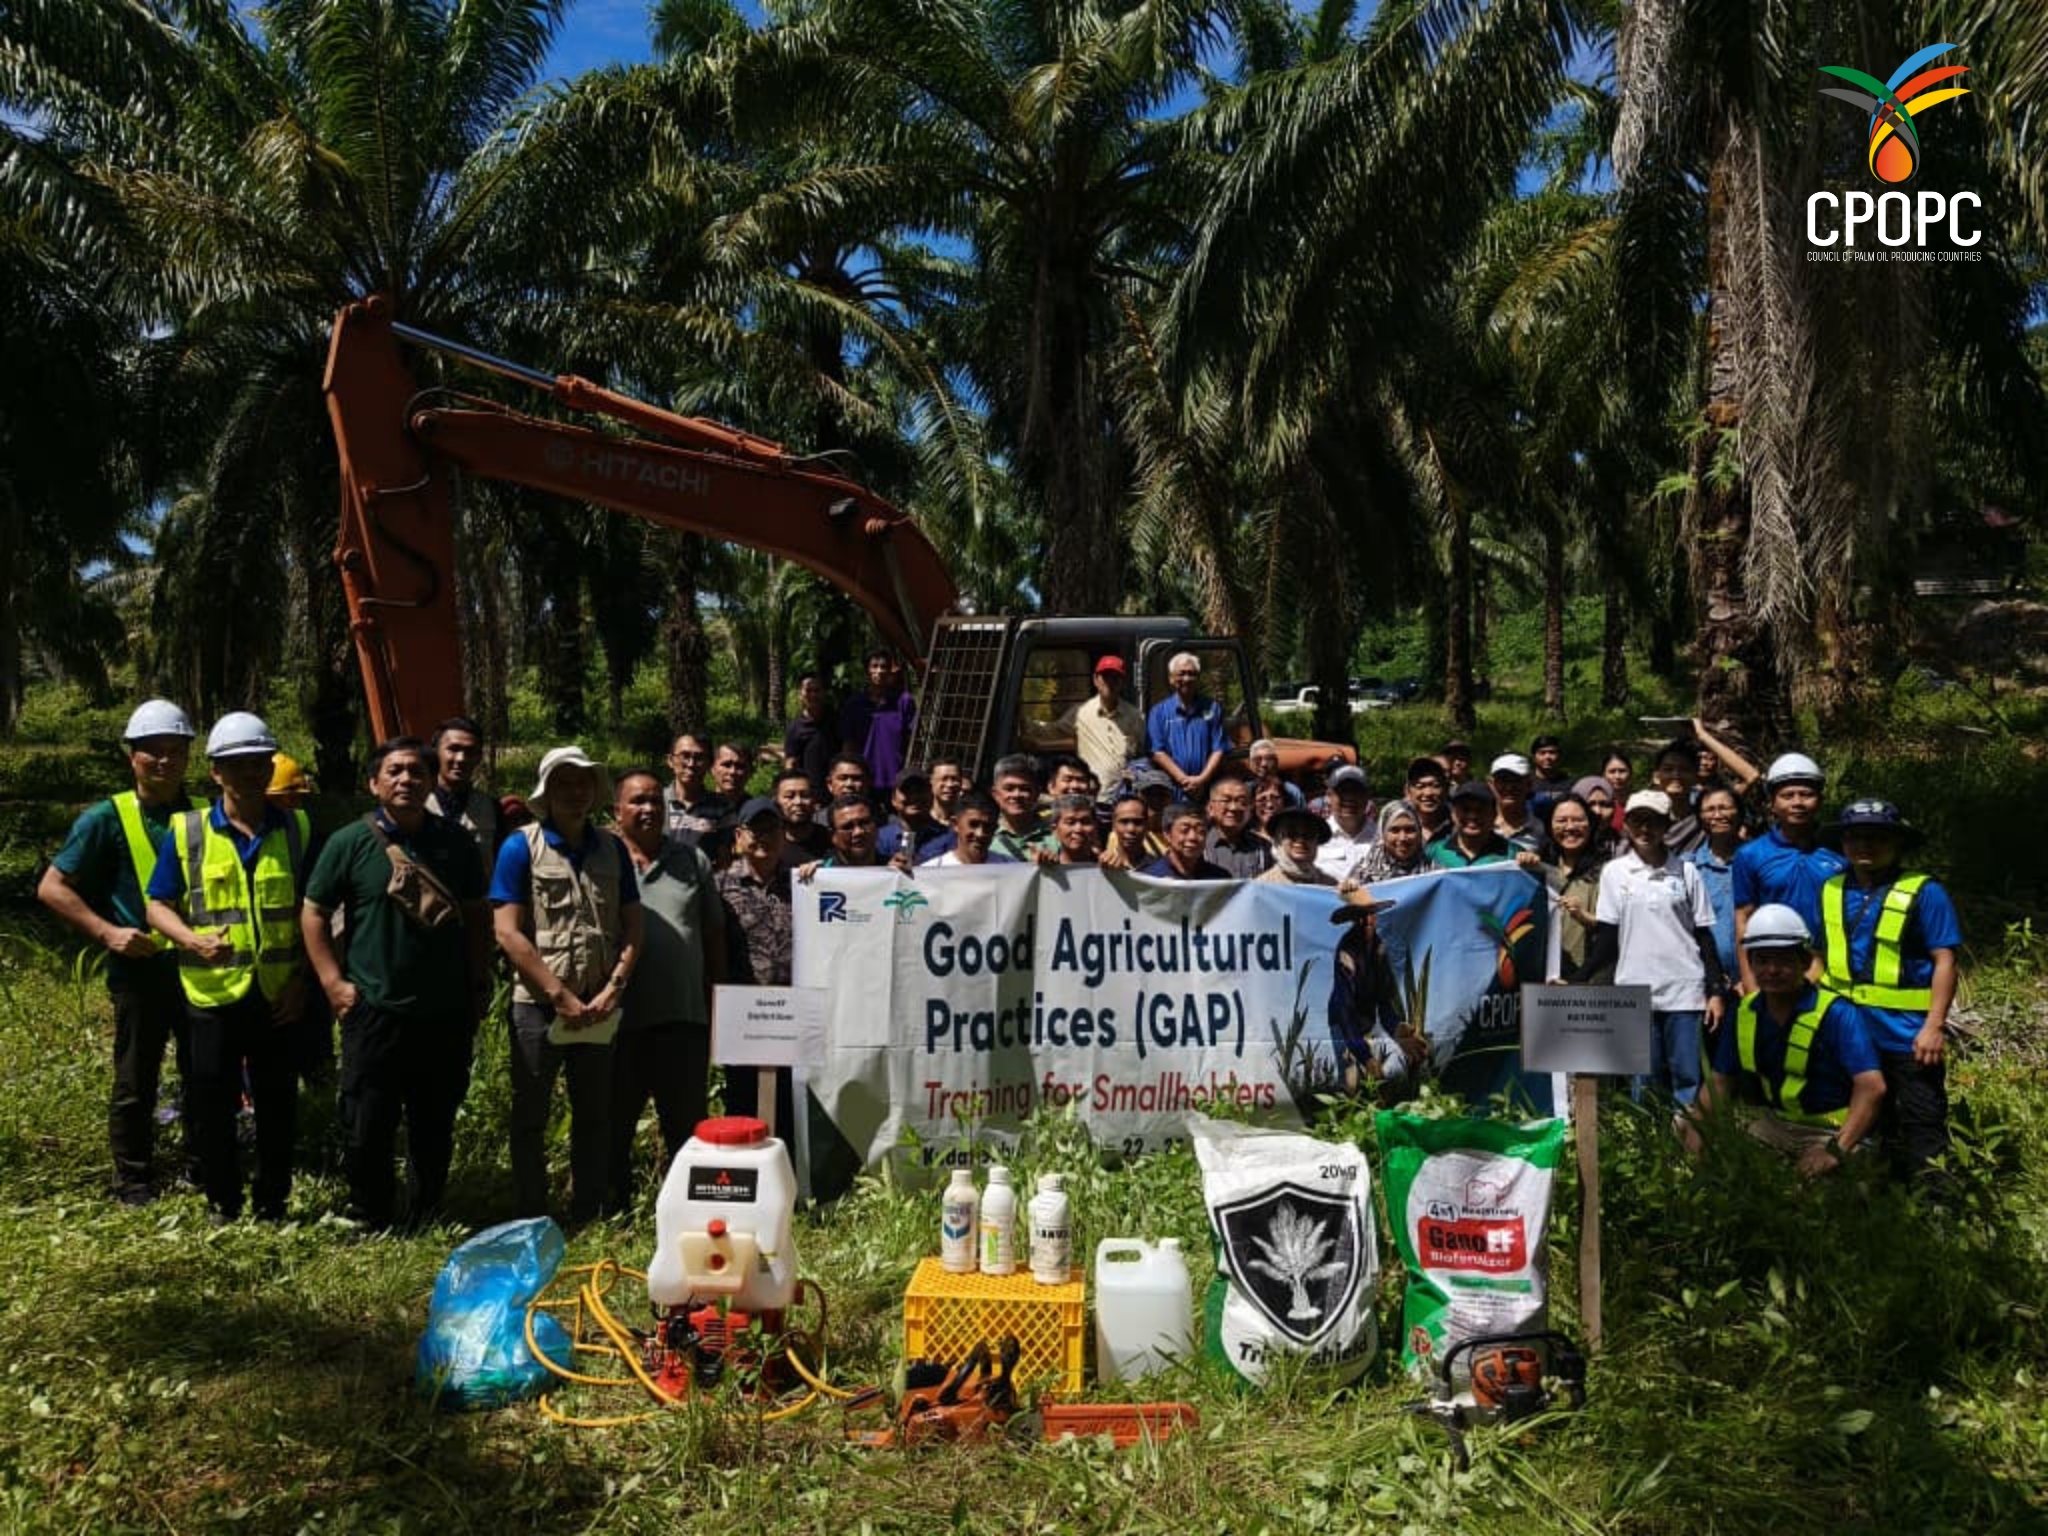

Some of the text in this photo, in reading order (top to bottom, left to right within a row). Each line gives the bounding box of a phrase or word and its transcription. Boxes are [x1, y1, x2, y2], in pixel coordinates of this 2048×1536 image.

[582, 449, 710, 497] HITACHI
[924, 914, 1292, 988] Good Agricultural
[925, 990, 1246, 1059] Practices (GAP)
[1480, 991, 1521, 1028] CPOP
[925, 1080, 1031, 1120] Training
[1042, 1072, 1083, 1108] for
